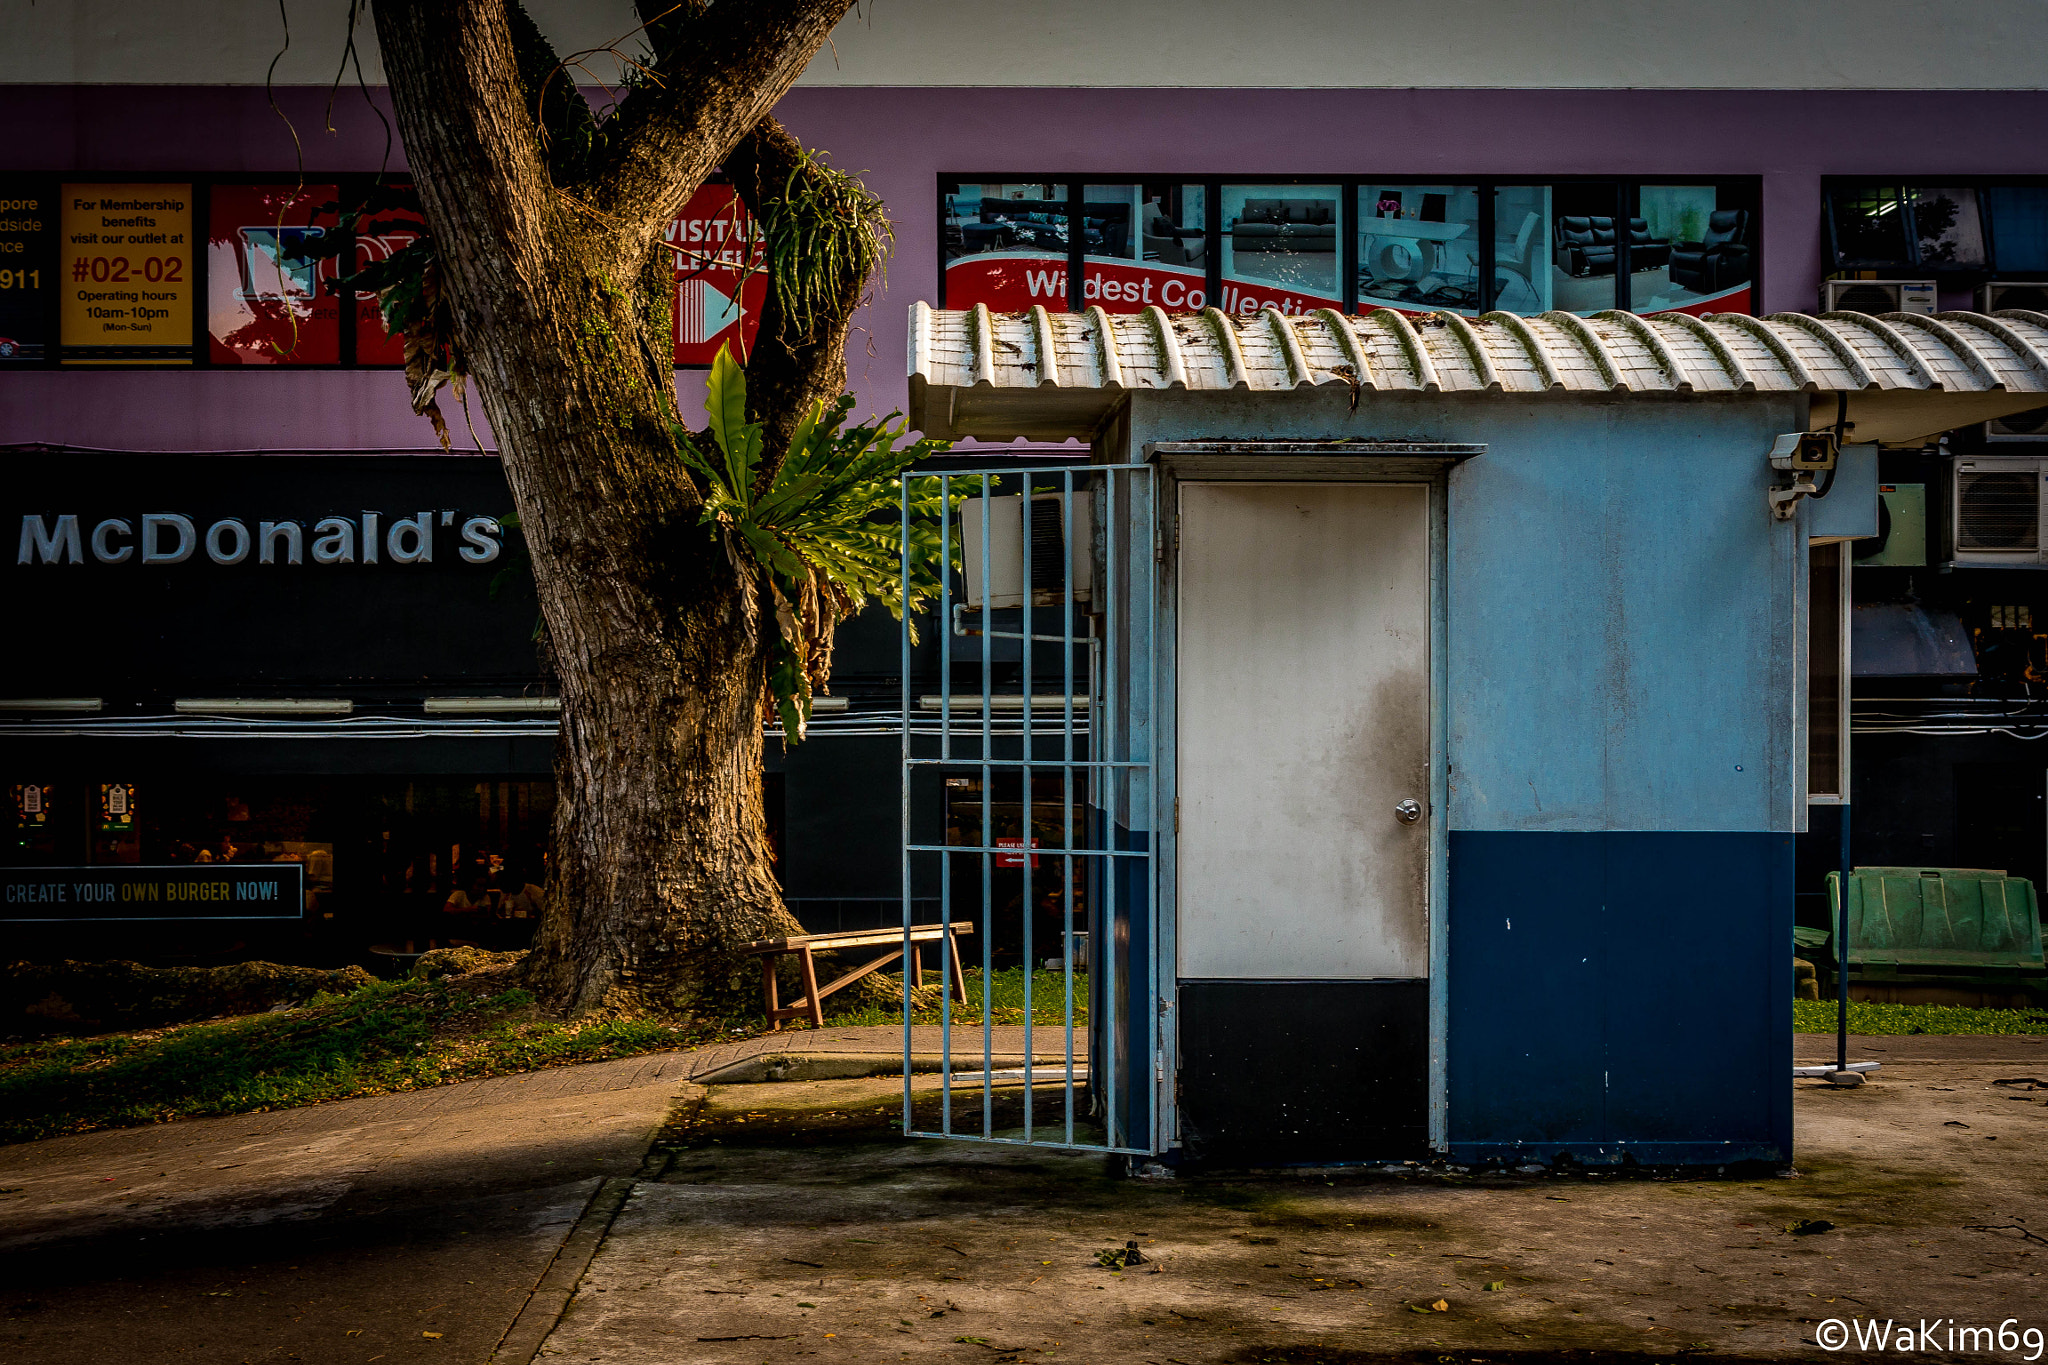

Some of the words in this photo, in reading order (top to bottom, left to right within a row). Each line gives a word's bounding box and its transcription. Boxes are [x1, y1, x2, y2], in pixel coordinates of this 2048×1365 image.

[74, 199, 96, 211] For
[100, 199, 185, 213] Membership
[102, 216, 156, 227] benefits
[71, 233, 98, 244] visit
[101, 235, 124, 245] our
[128, 233, 167, 244] outlet
[170, 233, 184, 245] at
[665, 219, 729, 242] VISIT
[72, 256, 183, 282] #02-02
[671, 250, 746, 271] LEVEL
[1025, 269, 1154, 304] Widest
[77, 290, 139, 302] Operating
[142, 290, 177, 301] hours
[86, 307, 169, 320] 10am-10pm
[103, 323, 152, 332] (Mon-Sun)
[17, 509, 502, 566] McDonald's
[6, 883, 67, 904] CREATE
[73, 882, 116, 903] YOUR
[121, 882, 159, 902] OWN
[167, 881, 230, 902] BURGER
[236, 880, 279, 901] NOW!
